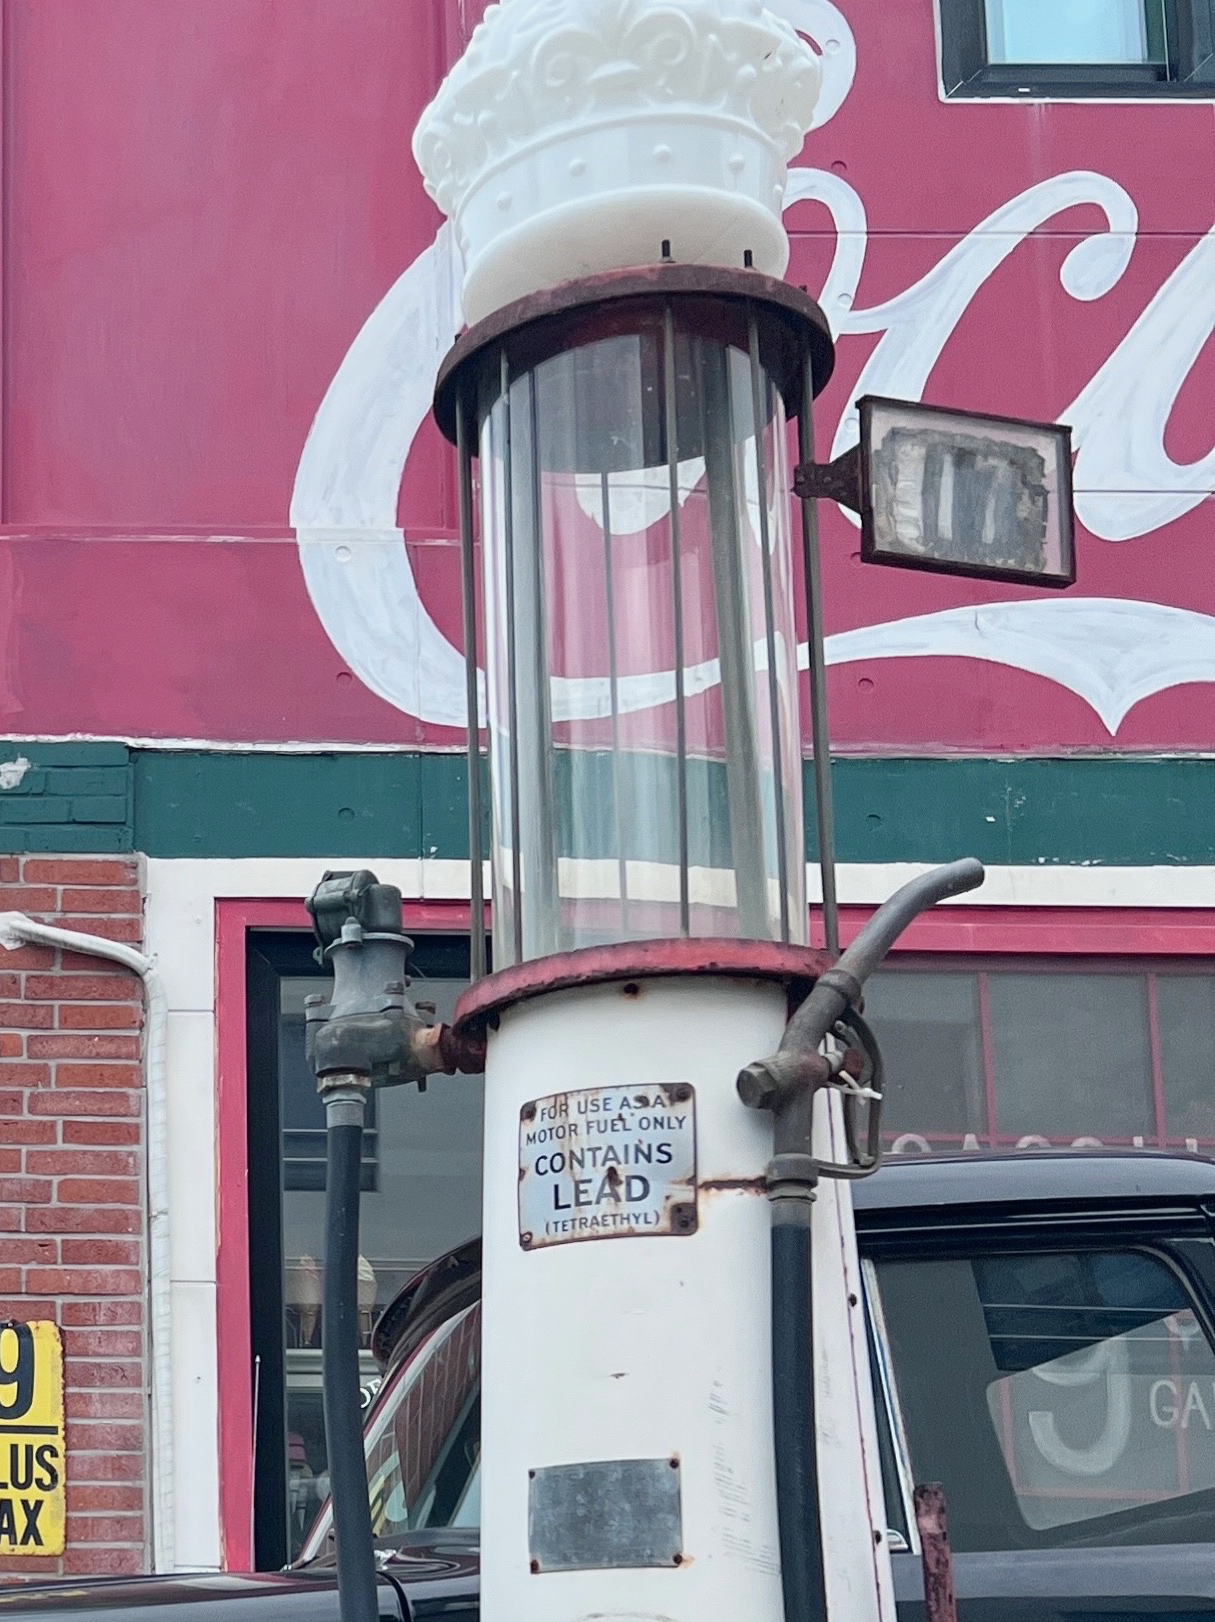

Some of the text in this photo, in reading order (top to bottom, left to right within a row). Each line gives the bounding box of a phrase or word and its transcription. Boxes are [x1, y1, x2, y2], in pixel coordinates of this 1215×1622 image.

[540, 1094, 667, 1122] FOR USE AS A
[526, 1115, 687, 1146] MOTOR FUEL ONLY
[535, 1142, 673, 1177] CONTAINS
[553, 1174, 650, 1210] LEAD
[545, 1210, 660, 1235] (TETRAETHYL)
